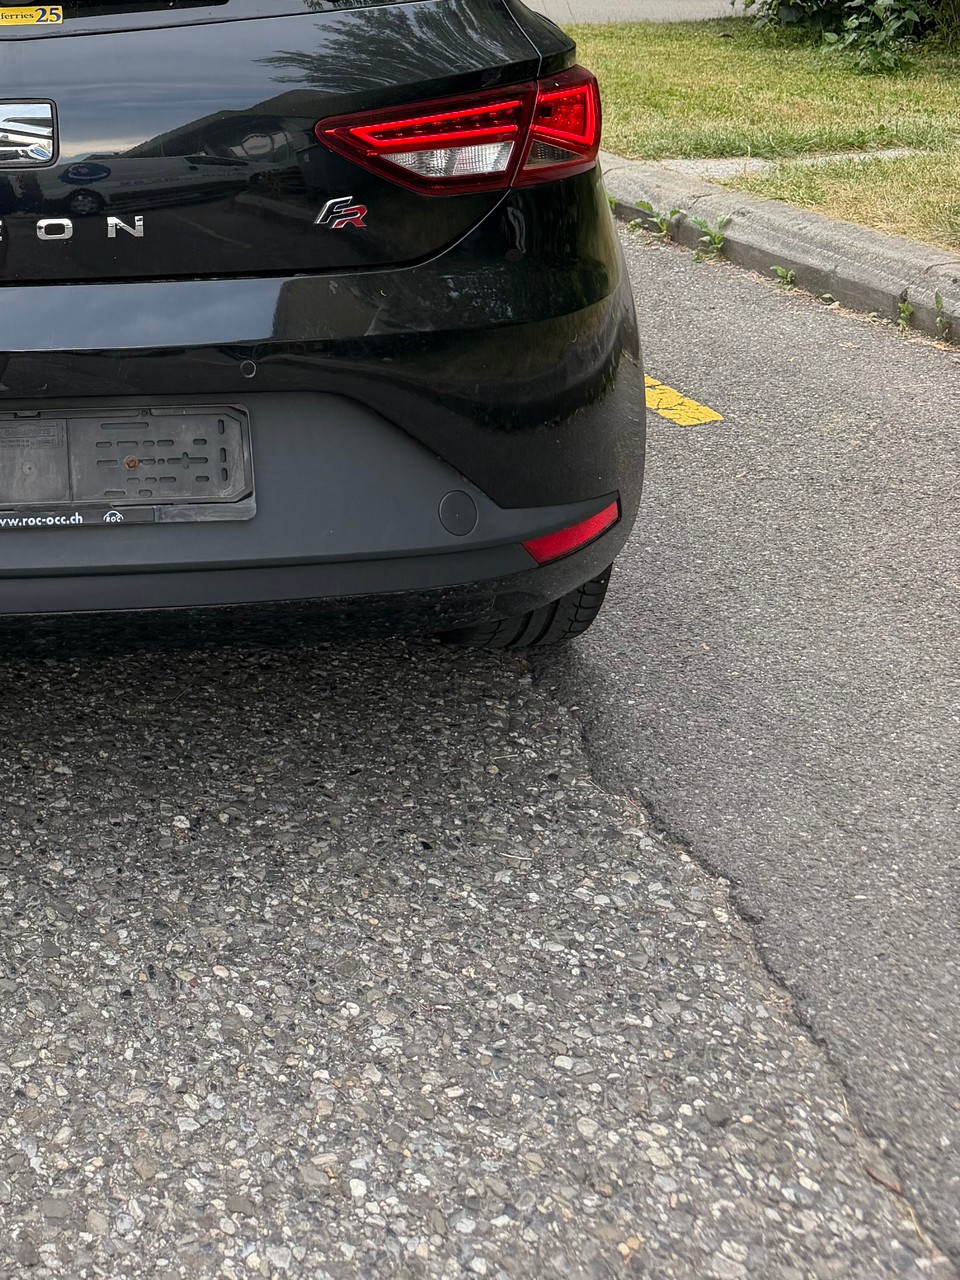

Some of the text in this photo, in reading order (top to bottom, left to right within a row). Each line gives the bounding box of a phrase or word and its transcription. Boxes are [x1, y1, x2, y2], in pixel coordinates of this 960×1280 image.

[0, 11, 34, 21] ferries
[35, 7, 61, 23] 25
[314, 195, 368, 229] FR
